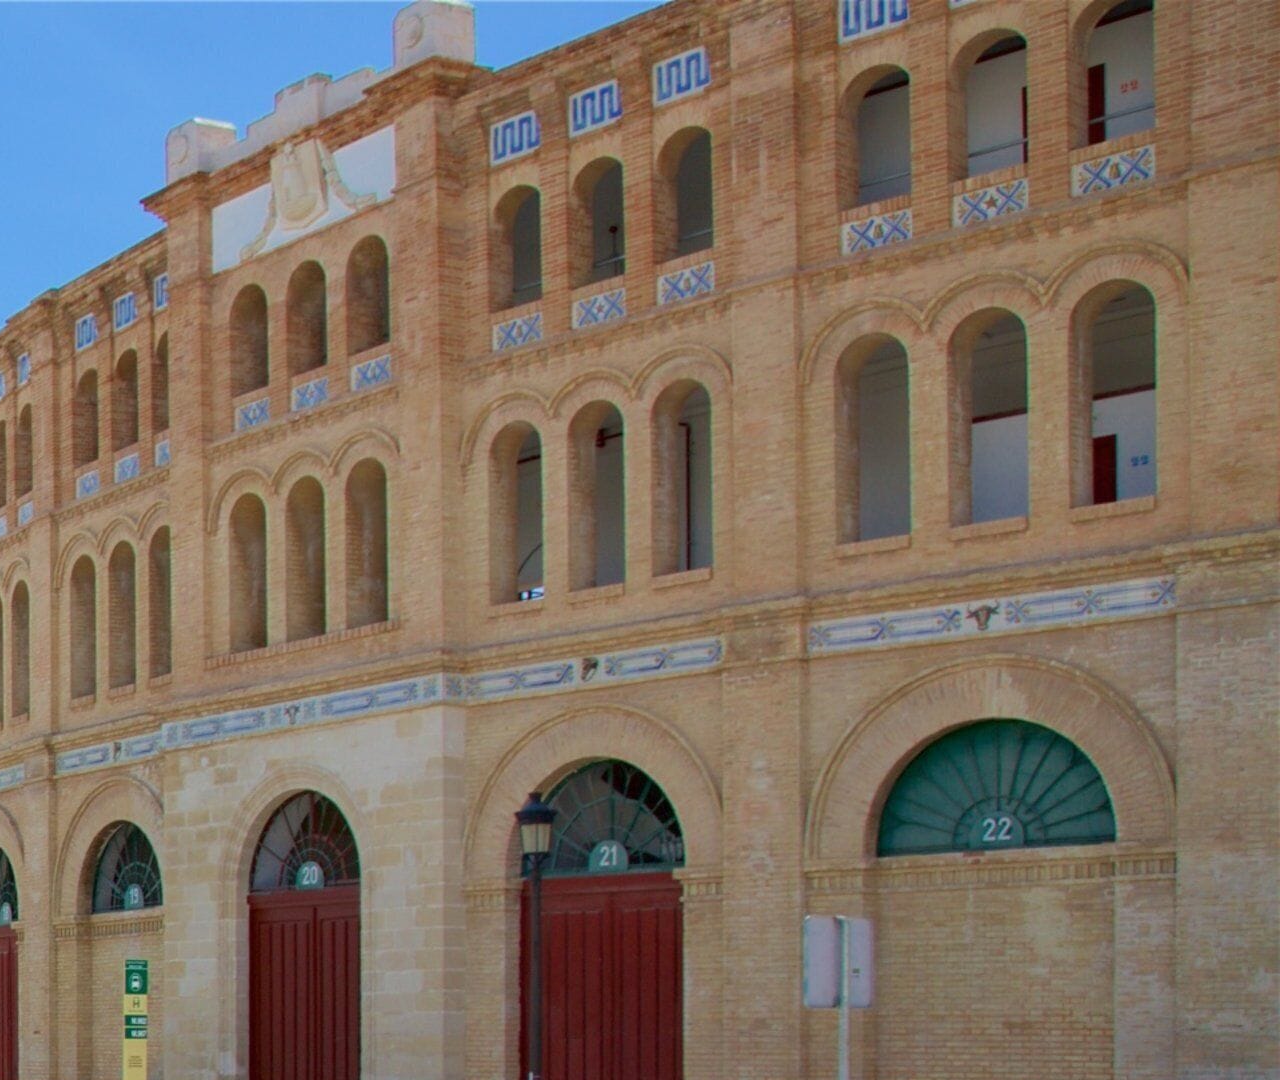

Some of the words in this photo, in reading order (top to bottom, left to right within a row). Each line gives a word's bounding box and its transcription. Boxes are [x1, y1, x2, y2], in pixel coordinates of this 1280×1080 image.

[982, 817, 1011, 842] 22
[600, 844, 617, 866] 21
[302, 865, 318, 885] 20
